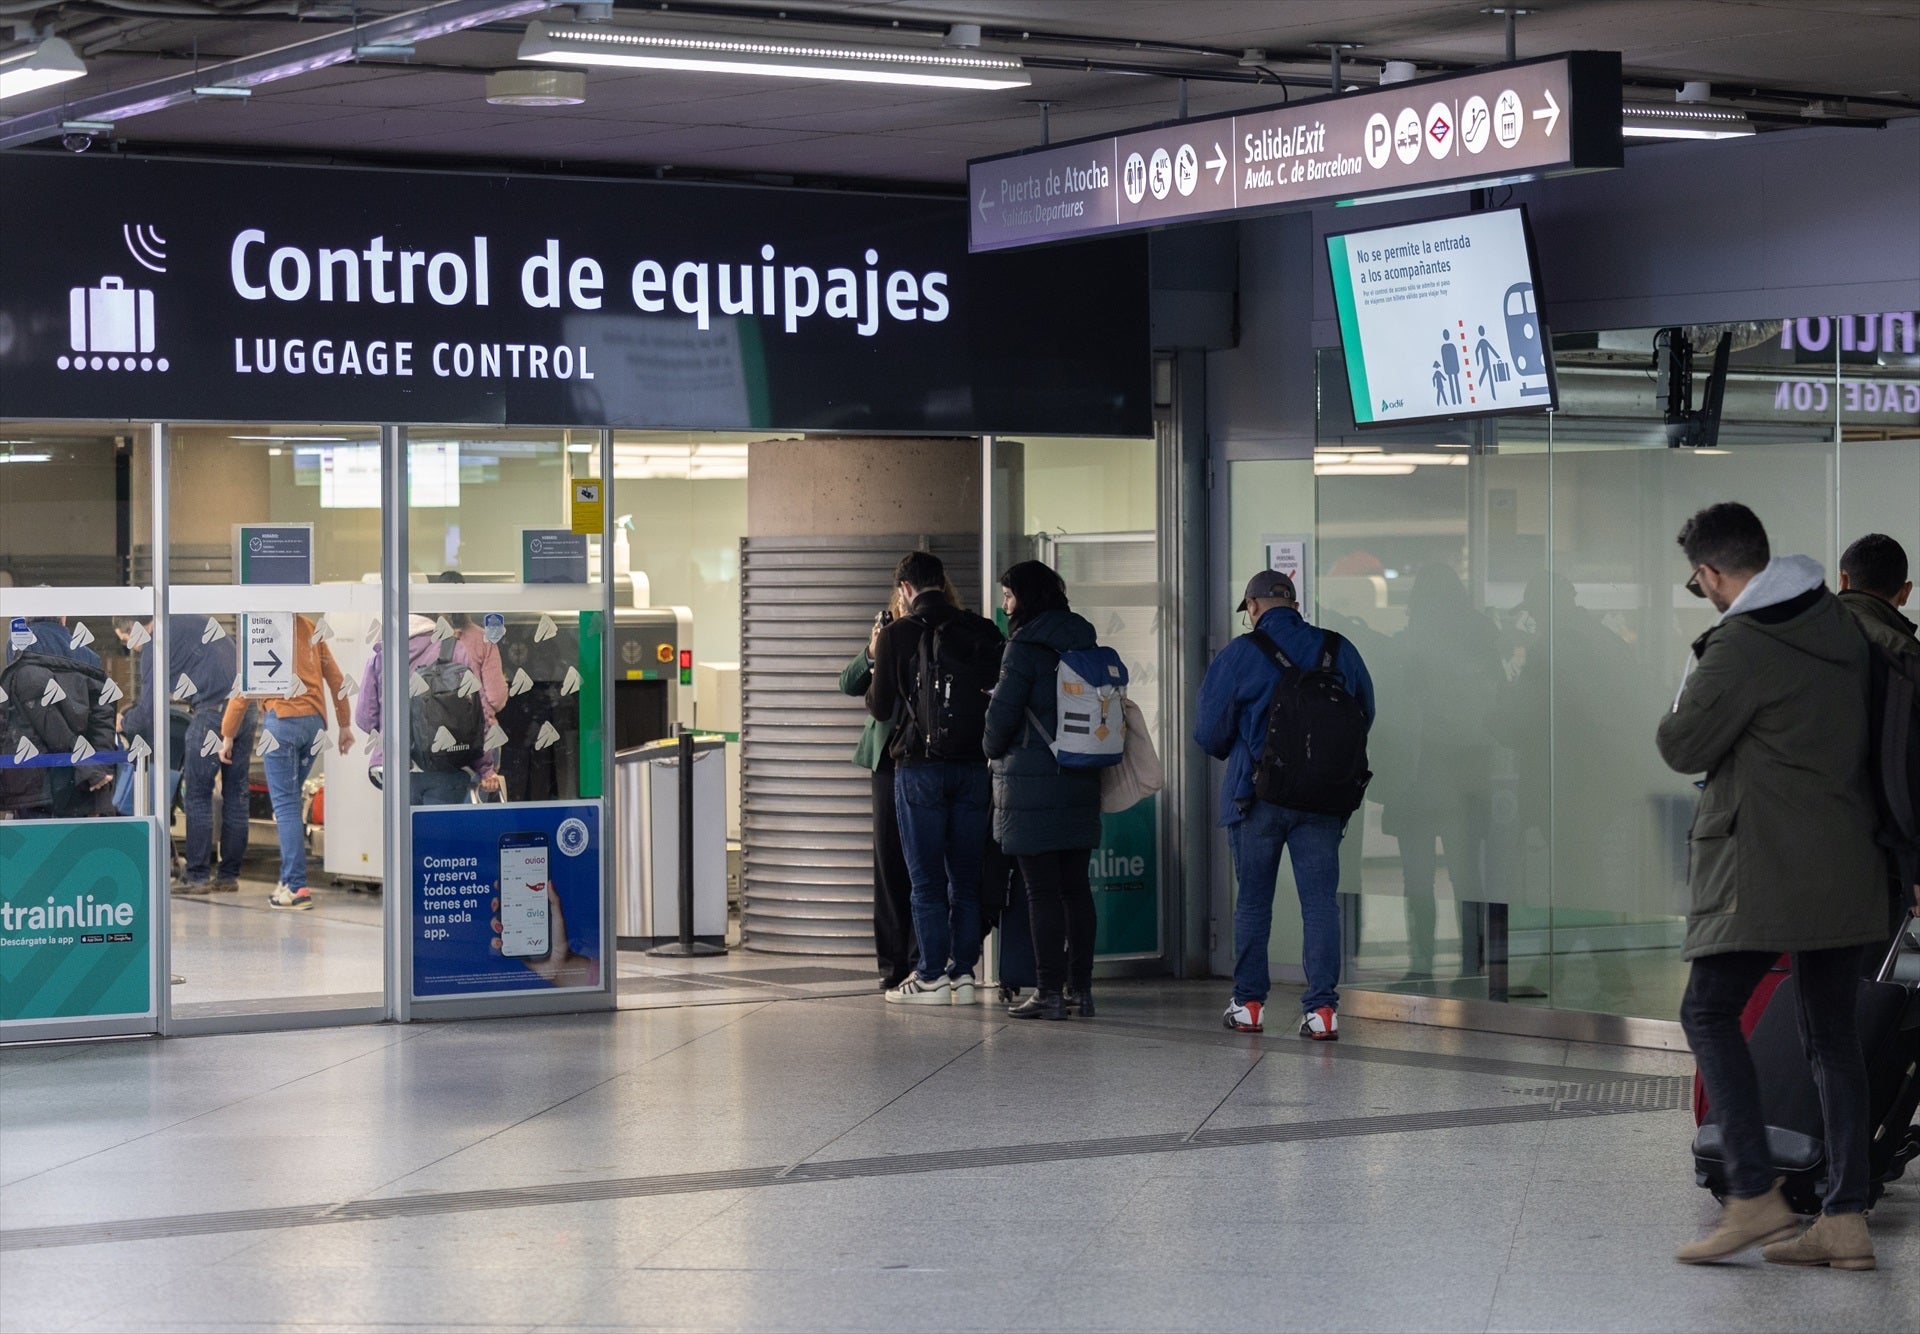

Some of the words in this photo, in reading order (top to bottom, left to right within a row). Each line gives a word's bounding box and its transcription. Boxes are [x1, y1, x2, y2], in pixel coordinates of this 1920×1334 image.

[1245, 120, 1326, 164] Salida/Exit
[1245, 165, 1274, 190] Avda.
[1277, 162, 1288, 185] C.
[1291, 160, 1305, 183] de
[1307, 153, 1362, 180] Barcelona
[1001, 176, 1041, 204] Puerta
[1045, 169, 1061, 197] de
[1064, 160, 1109, 194] Atocha
[1002, 200, 1084, 227] Salidas/Departures
[1356, 250, 1369, 264] No
[1372, 249, 1381, 262] se
[1384, 242, 1420, 263] permite
[1422, 240, 1431, 254] la
[1434, 234, 1471, 252] entrada
[1360, 273, 1366, 284] a
[1368, 269, 1381, 283] los
[1384, 260, 1451, 280] acompañantes
[230, 228, 489, 306] Control
[521, 239, 604, 310] de
[631, 243, 950, 337] equipajes
[235, 337, 413, 376] LUGGAGE
[432, 342, 595, 380] CONTROL
[251, 617, 273, 625] Utilice
[251, 637, 274, 645] puerta
[423, 856, 478, 870] Compara
[423, 873, 431, 885] y
[434, 871, 477, 882] reserva
[423, 883, 457, 896] todos
[459, 883, 490, 895] estos
[0, 894, 134, 931] trainline
[423, 899, 460, 911] trenes
[463, 898, 478, 909] en
[424, 914, 445, 924] una
[448, 910, 472, 923] sola
[0, 936, 47, 947] Descárgate
[48, 936, 56, 944] la
[58, 936, 74, 945] app
[424, 928, 450, 941] app.
